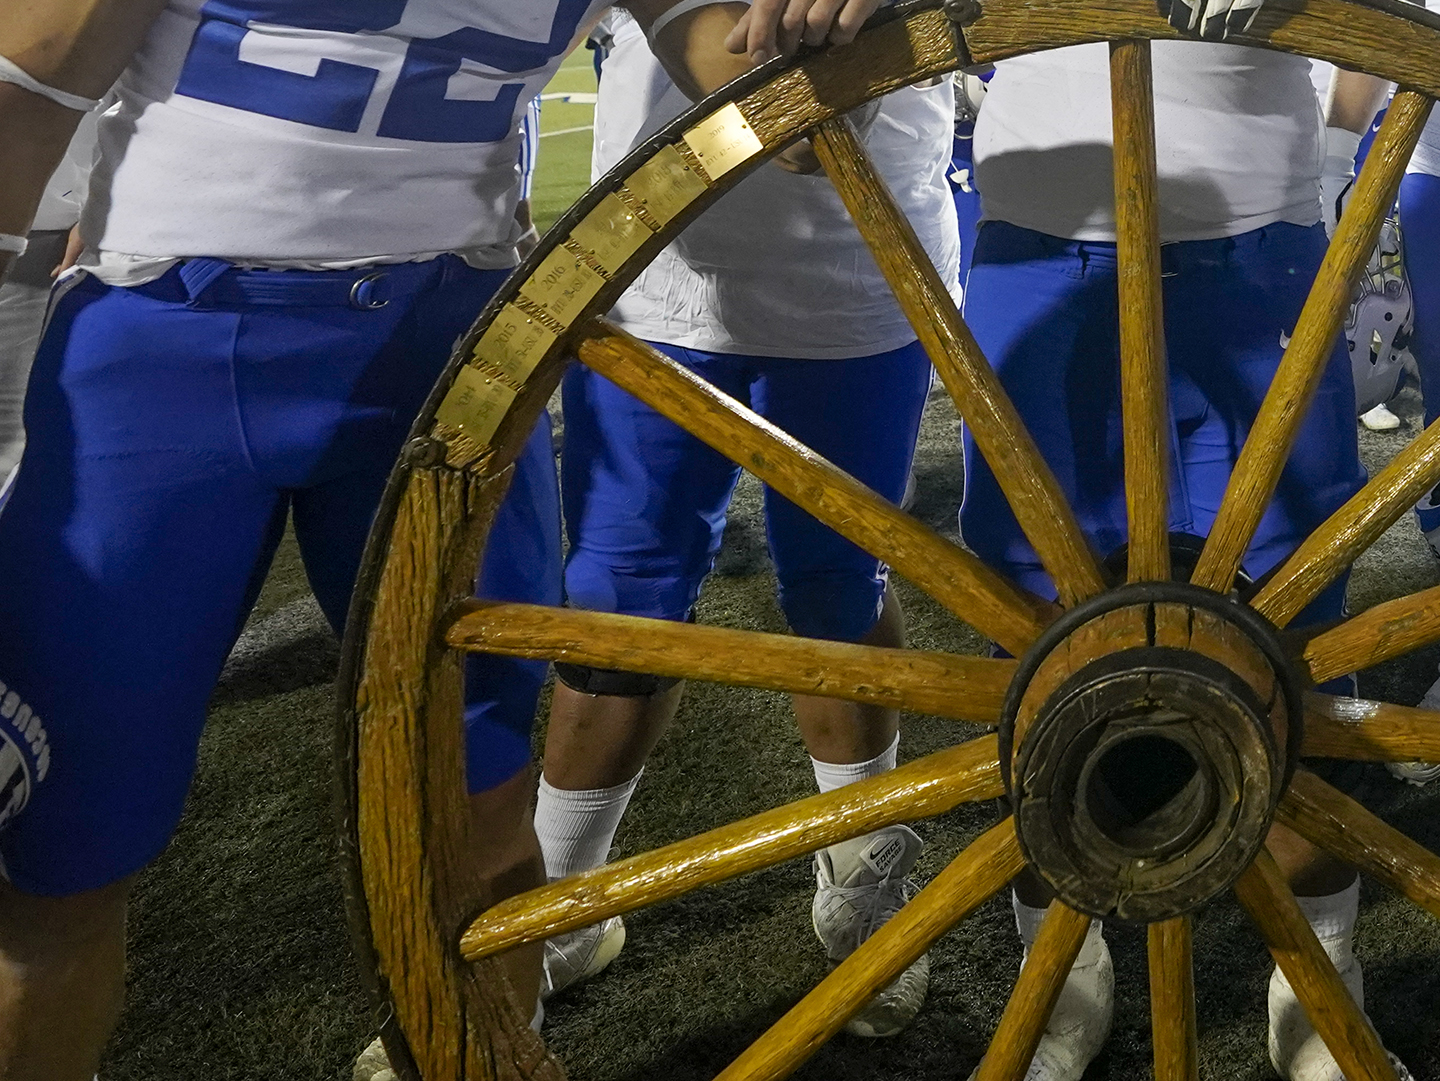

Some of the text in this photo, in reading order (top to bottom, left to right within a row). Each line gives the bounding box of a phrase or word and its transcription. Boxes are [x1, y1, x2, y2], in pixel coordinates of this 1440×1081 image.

[707, 124, 725, 139] 2019
[540, 266, 566, 291] 2016
[493, 323, 517, 347] 2015
[875, 838, 901, 868] FORCE
